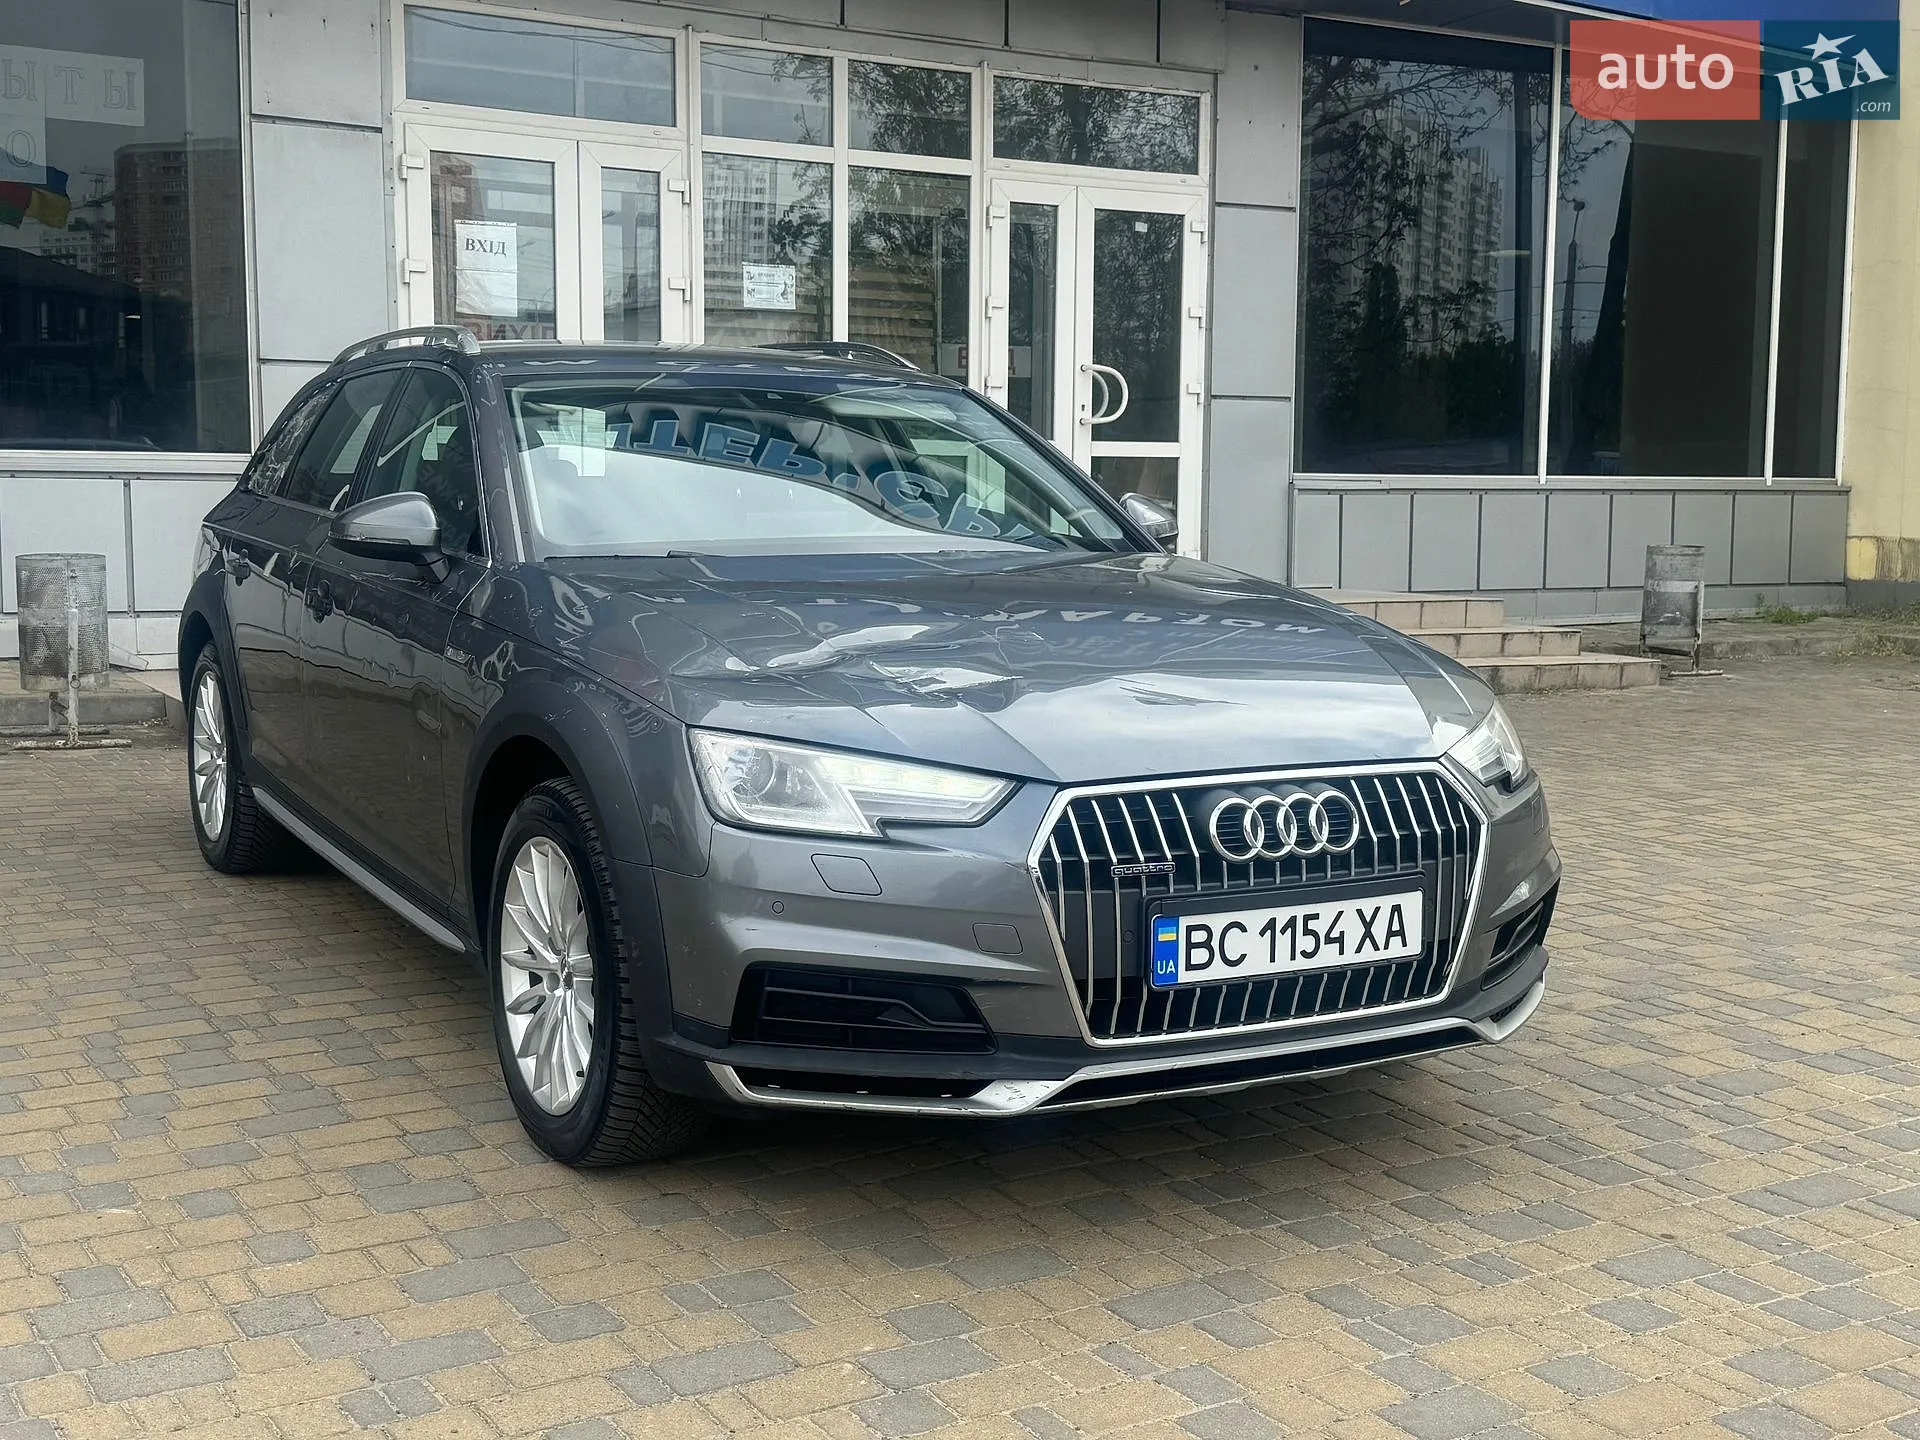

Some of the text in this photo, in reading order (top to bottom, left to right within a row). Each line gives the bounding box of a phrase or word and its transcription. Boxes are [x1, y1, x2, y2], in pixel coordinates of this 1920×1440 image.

[464, 237, 507, 257] ВХІД
[1114, 864, 1173, 876] quattro
[1184, 902, 1409, 972] BC 1154 XA
[1157, 958, 1176, 976] UA
